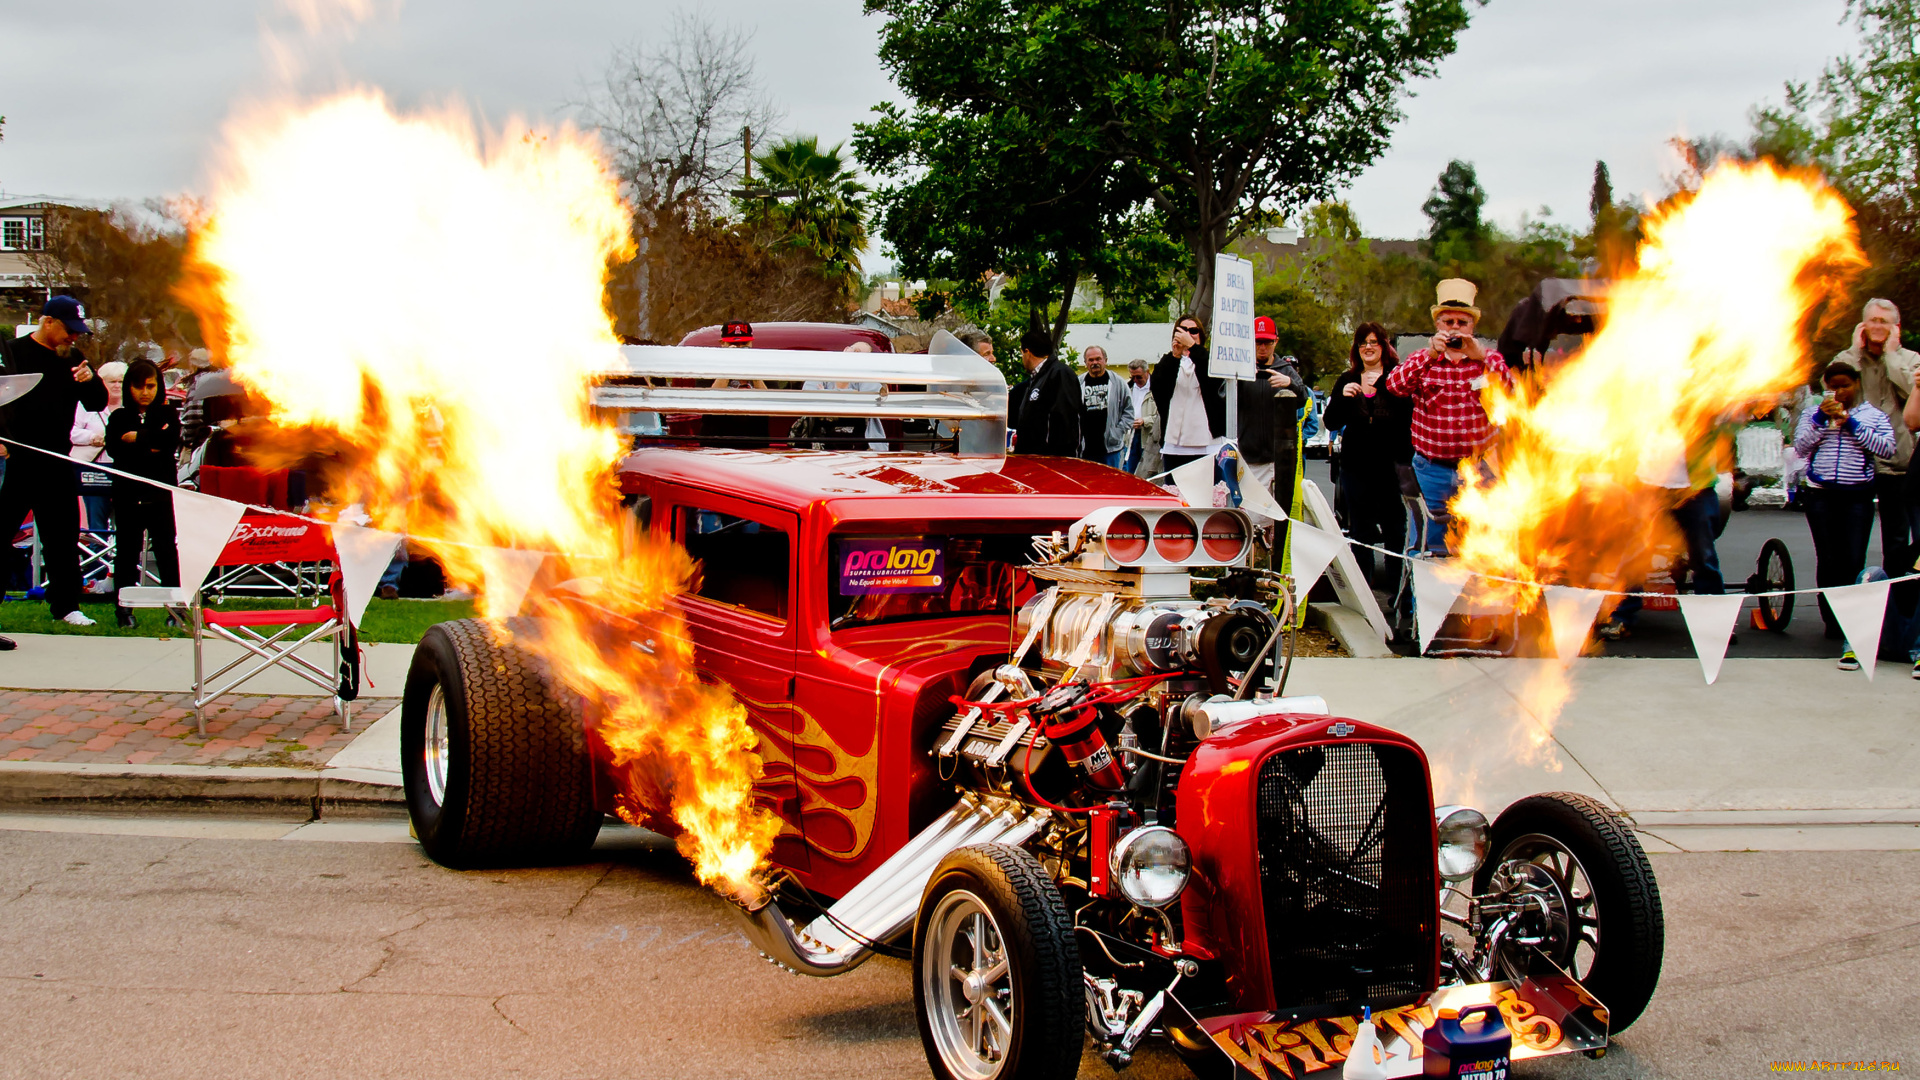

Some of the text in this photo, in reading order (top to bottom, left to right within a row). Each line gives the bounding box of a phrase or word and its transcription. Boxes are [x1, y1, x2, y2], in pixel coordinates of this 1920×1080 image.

[1226, 273, 1245, 290] BREA
[1221, 297, 1249, 315] BAPTIST
[1219, 321, 1250, 339] CHURCH
[1217, 346, 1251, 363] PARKING
[228, 523, 308, 543] Extreme
[843, 546, 936, 577] prolong
[859, 578, 875, 587] Equal
[892, 577, 909, 585] World
[1150, 637, 1180, 649] BDS
[1091, 747, 1109, 765] MS
[1458, 1060, 1494, 1075] prolong
[1461, 1071, 1493, 1080] NITRO
[1495, 1068, 1506, 1080] 70
